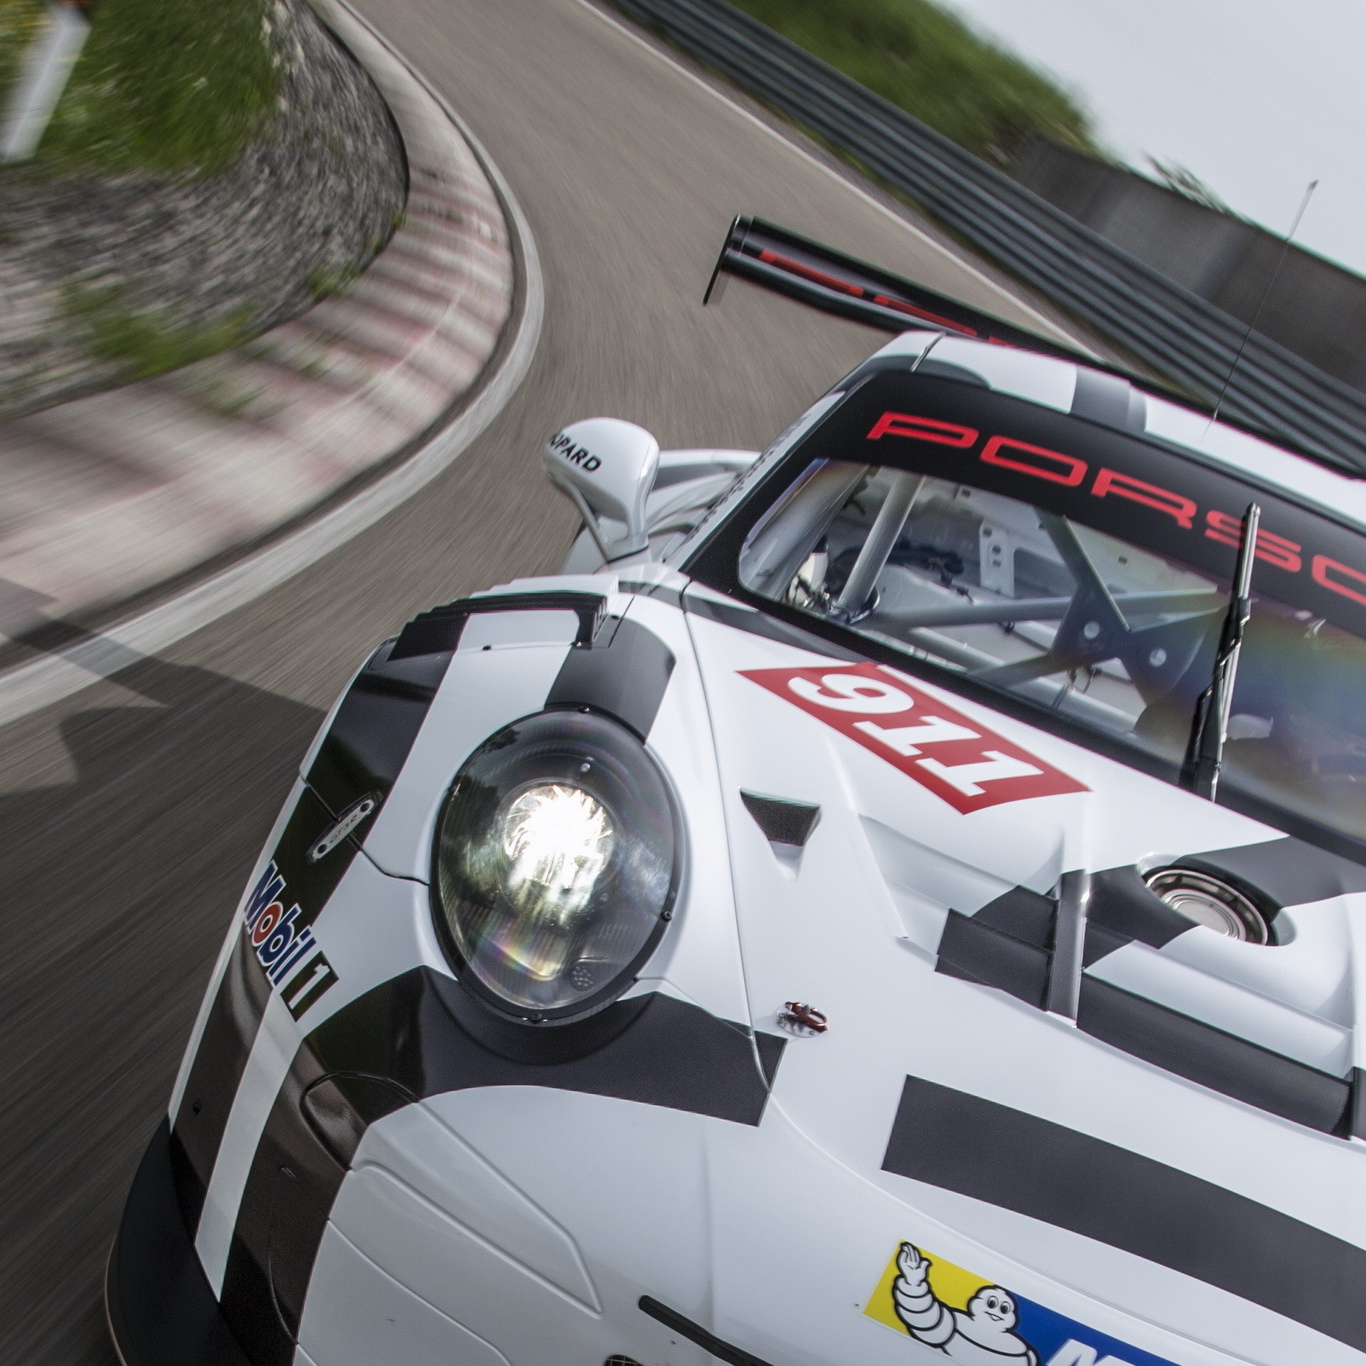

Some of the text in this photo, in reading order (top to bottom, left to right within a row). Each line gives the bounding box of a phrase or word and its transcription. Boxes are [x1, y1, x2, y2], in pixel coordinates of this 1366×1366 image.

[787, 672, 1046, 797] 911
[244, 860, 332, 1012] Mobil 1
